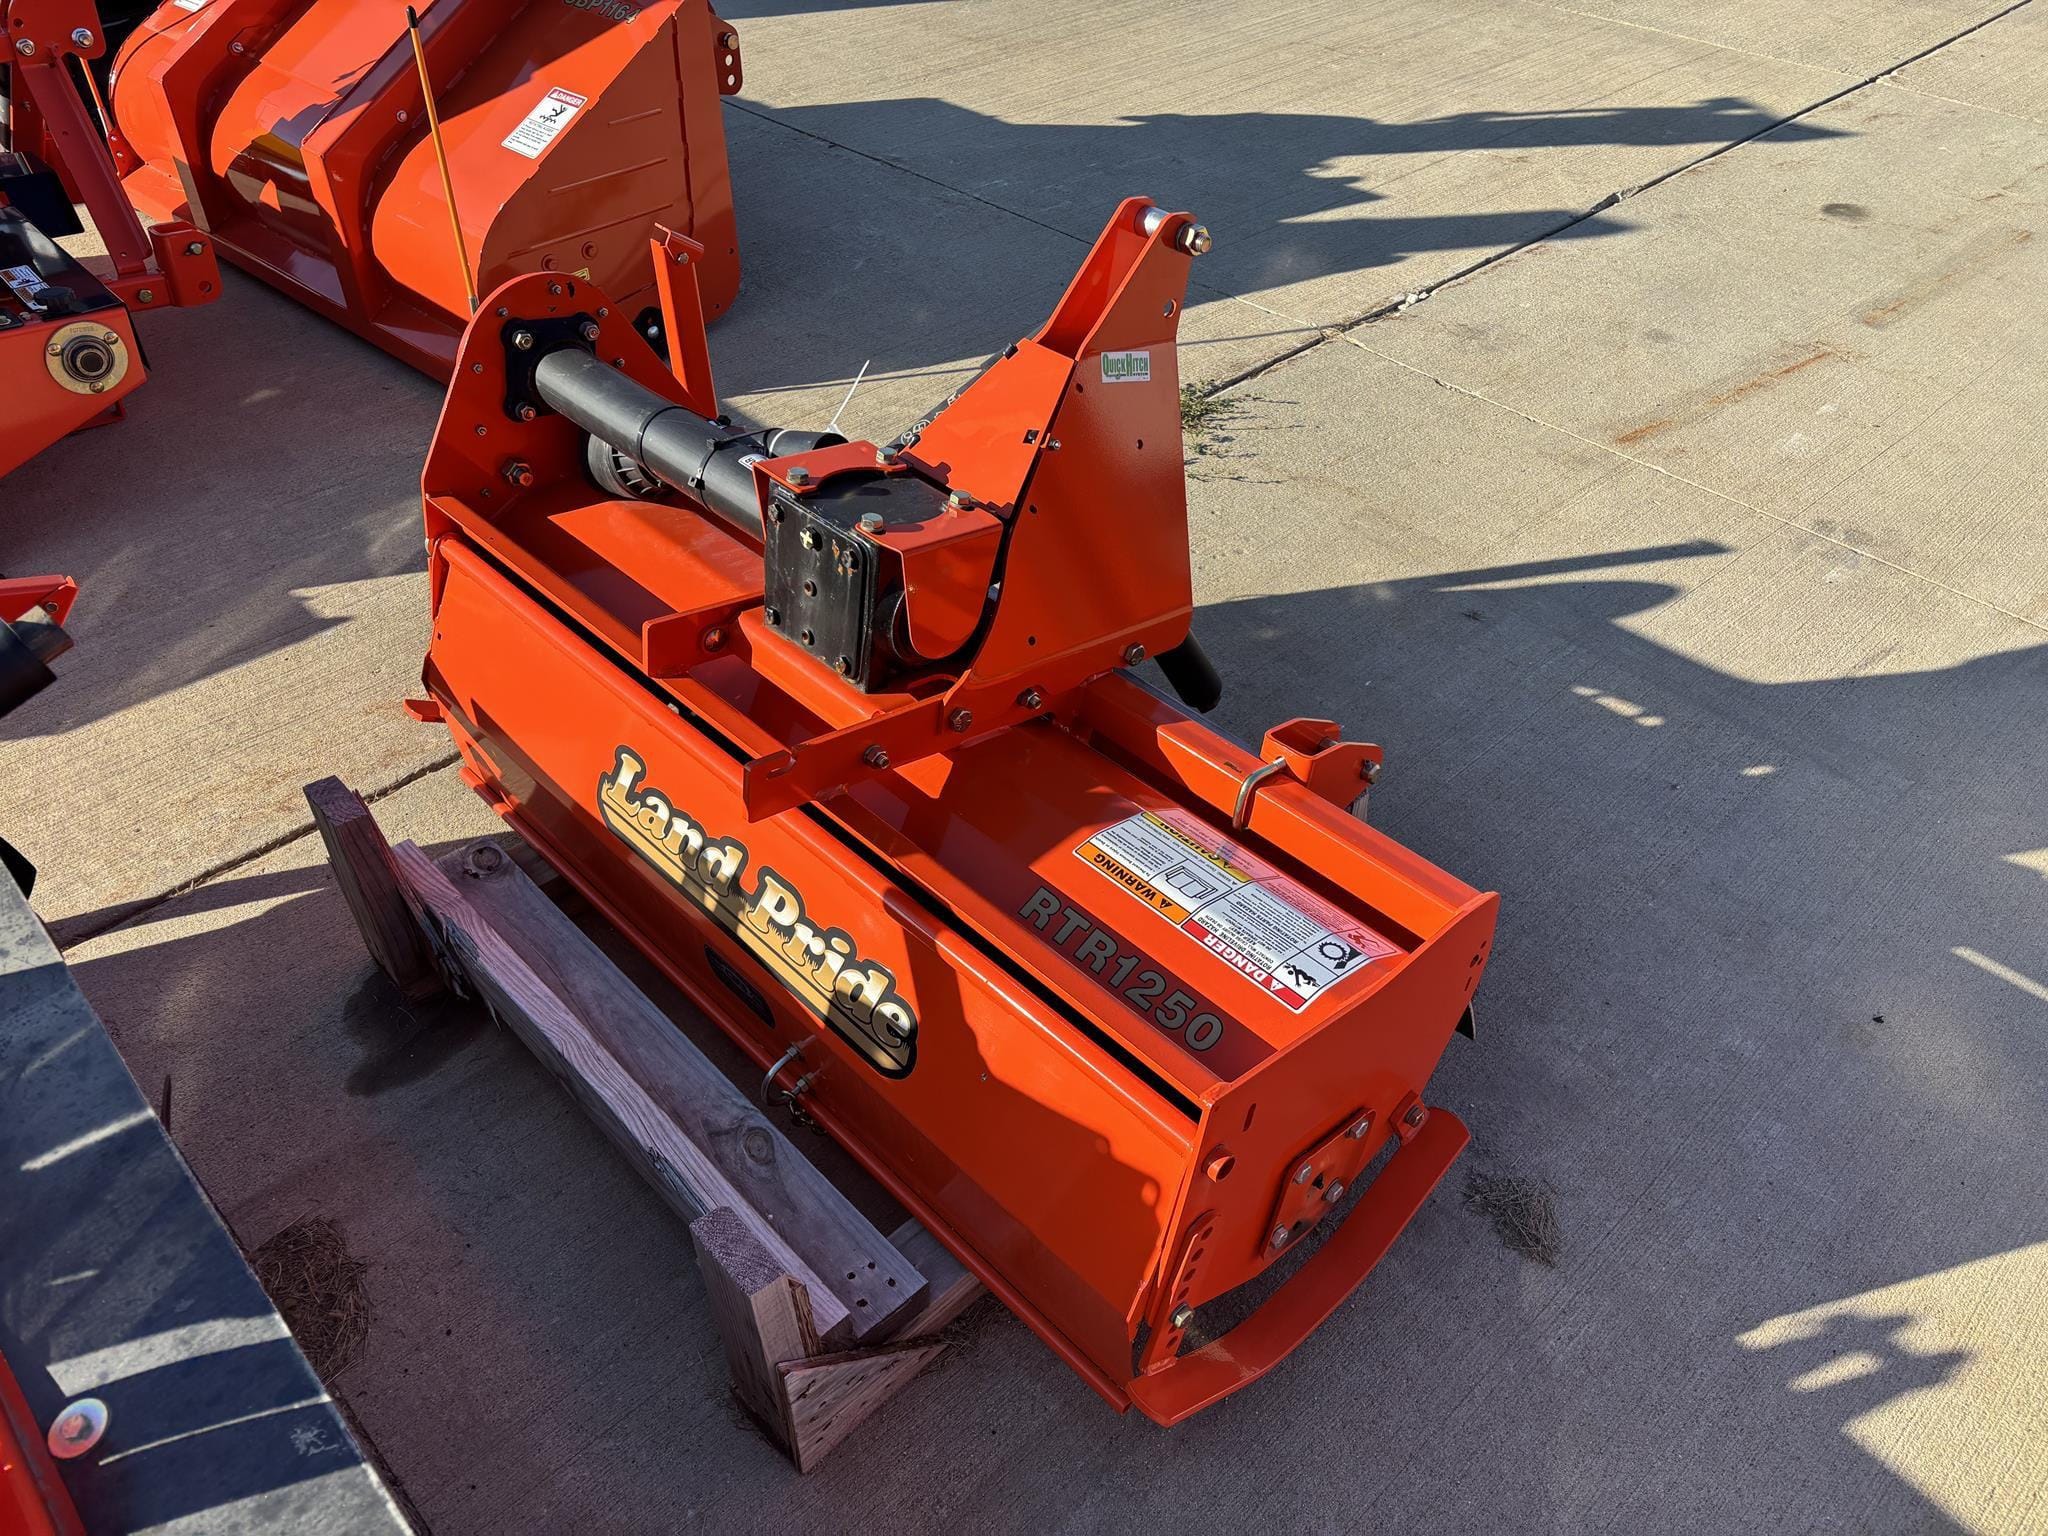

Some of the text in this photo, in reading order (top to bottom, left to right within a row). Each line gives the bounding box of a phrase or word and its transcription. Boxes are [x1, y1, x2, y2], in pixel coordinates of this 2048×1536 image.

[557, 91, 582, 106] DANGER
[1091, 852, 1157, 901] WARNING
[604, 751, 744, 898] Land
[745, 874, 913, 1048] Pride
[1204, 914, 1218, 924] DEATH
[1234, 900, 1299, 944] ROTATING PARTS HAZARD
[1221, 926, 1236, 936] INJURY
[1196, 916, 1272, 970] ROTATING DRIVELINE HAZARD
[1234, 935, 1248, 945] CAUSE
[1242, 935, 1257, 945] KEEP
[1246, 943, 1257, 951] WILL
[1201, 932, 1268, 982] DANGER
[1255, 950, 1274, 963] CONTACT
[1017, 885, 1224, 1052] RTR1250
